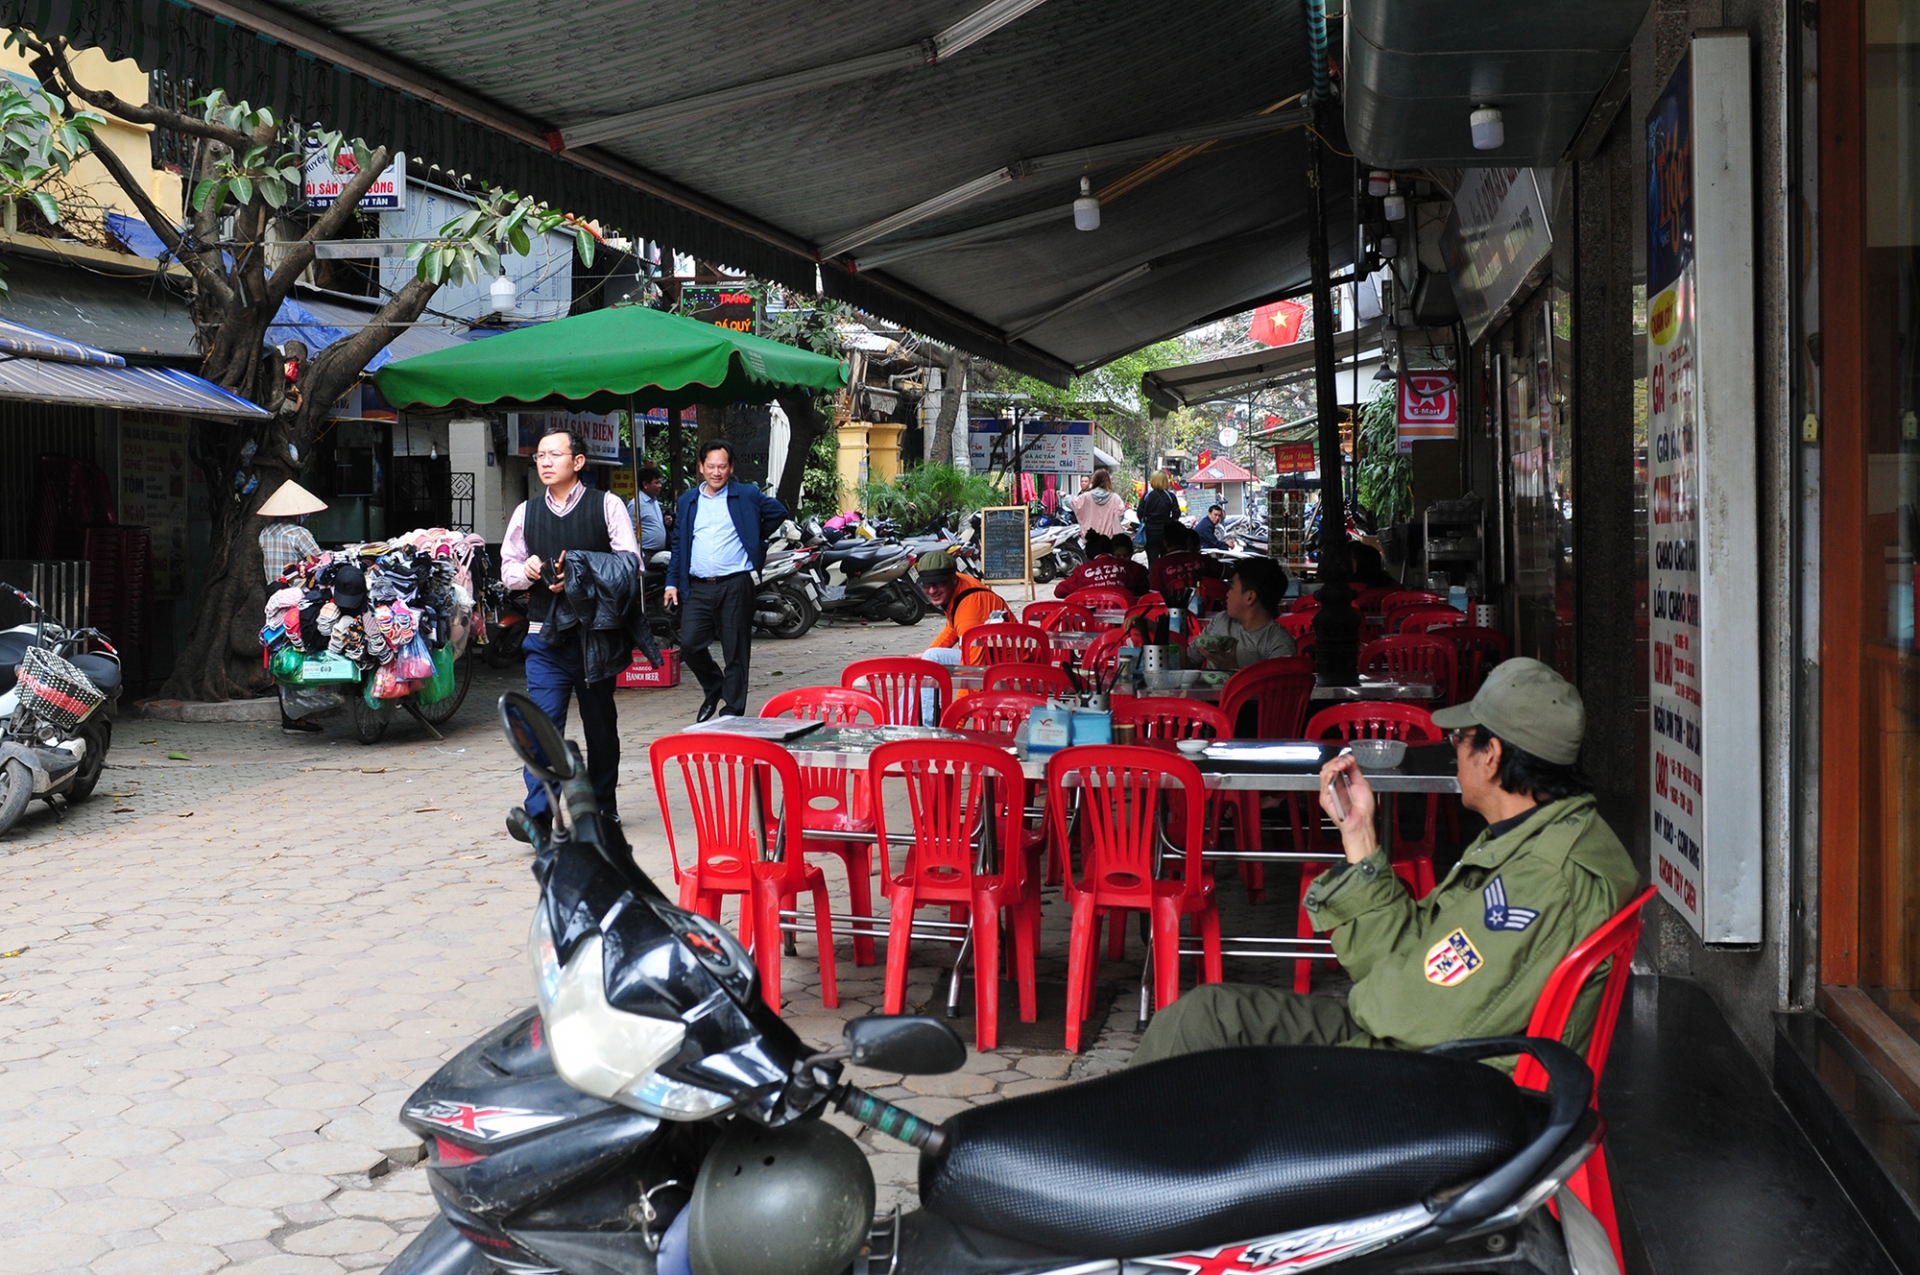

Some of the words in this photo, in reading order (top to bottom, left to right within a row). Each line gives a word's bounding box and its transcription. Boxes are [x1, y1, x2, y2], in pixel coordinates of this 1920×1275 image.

[306, 180, 316, 195] ẢI
[316, 199, 327, 207] 30
[719, 293, 751, 304] TRANG
[1652, 351, 1666, 415] GÀ
[1414, 407, 1442, 416] S-Mart
[124, 444, 144, 456] CUA
[1656, 426, 1669, 463] GÀ
[123, 475, 144, 494] TÔM
[626, 671, 645, 681] HANOI
[645, 671, 660, 682] BEER
[1659, 854, 1673, 889] KHOAI
[1453, 941, 1470, 965] USA
